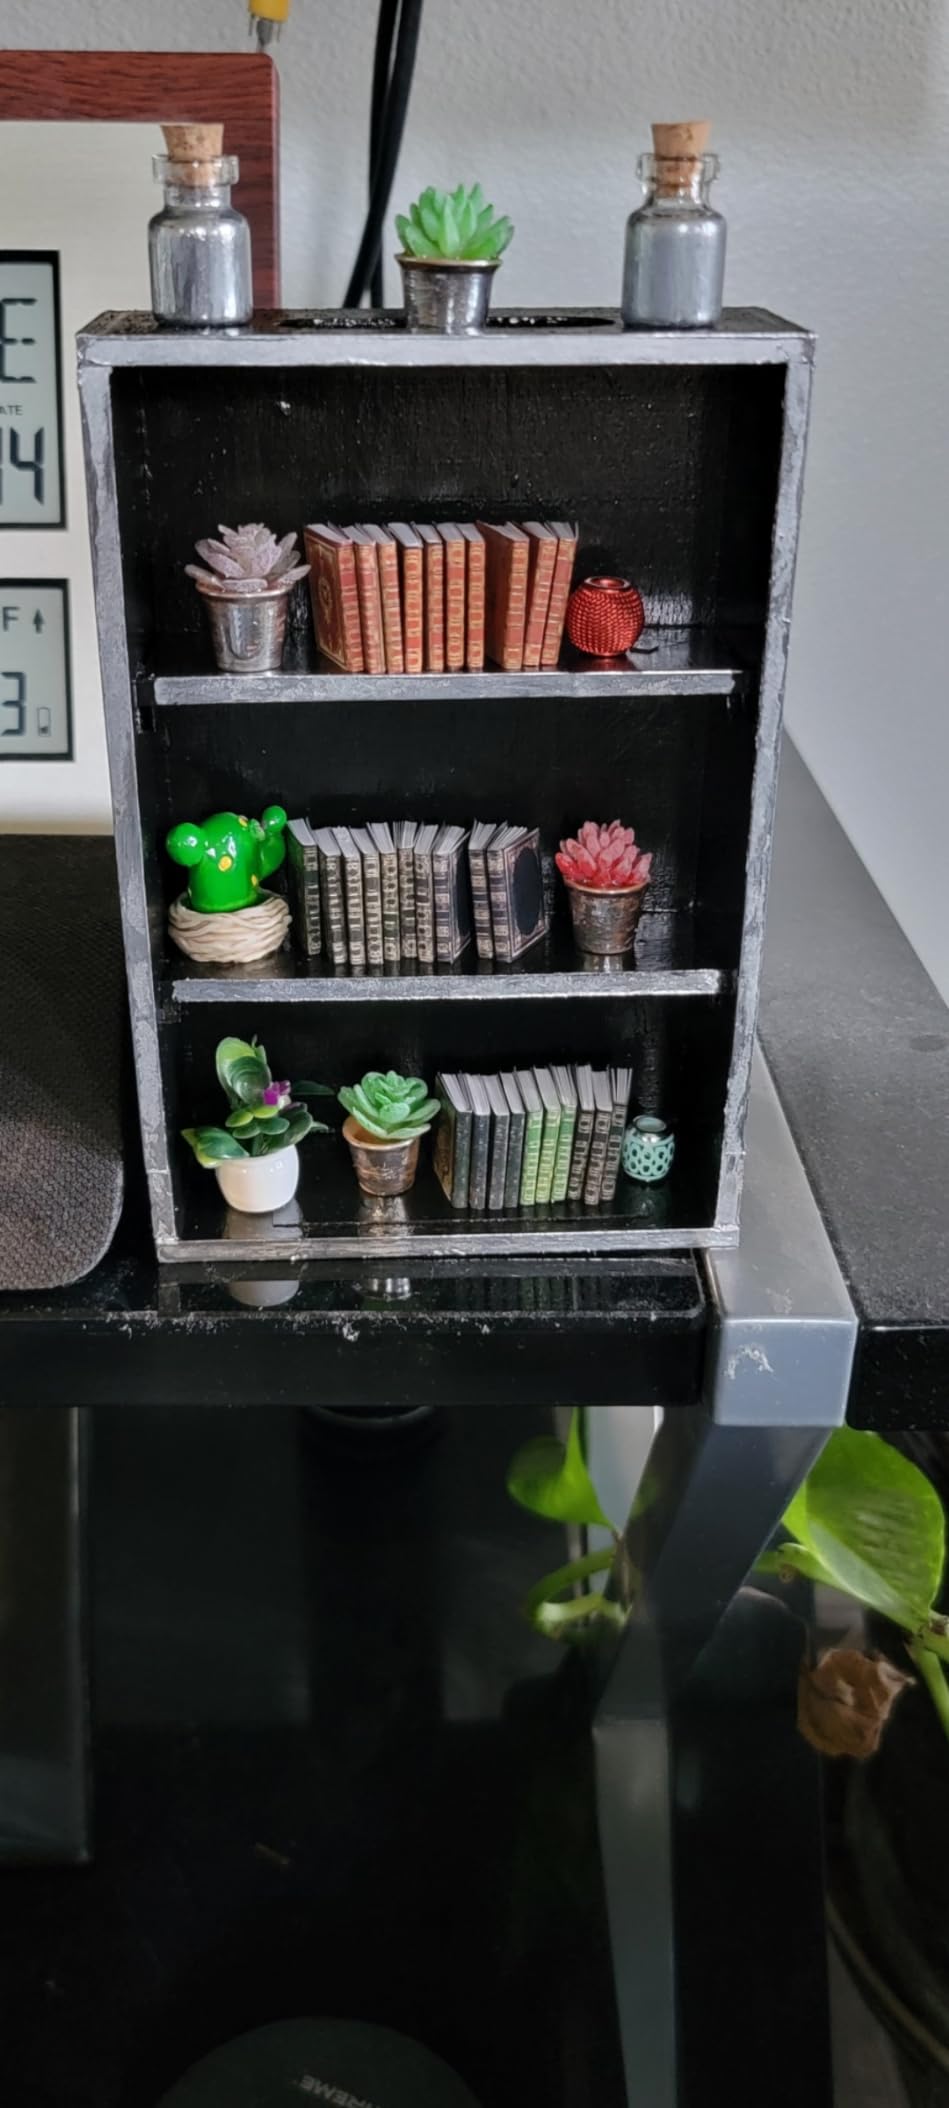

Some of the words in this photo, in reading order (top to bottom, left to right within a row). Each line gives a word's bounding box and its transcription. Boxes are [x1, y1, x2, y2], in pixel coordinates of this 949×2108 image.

[0, 298, 37, 384] E
[0, 427, 44, 506] 4
[0, 671, 27, 736] 3
